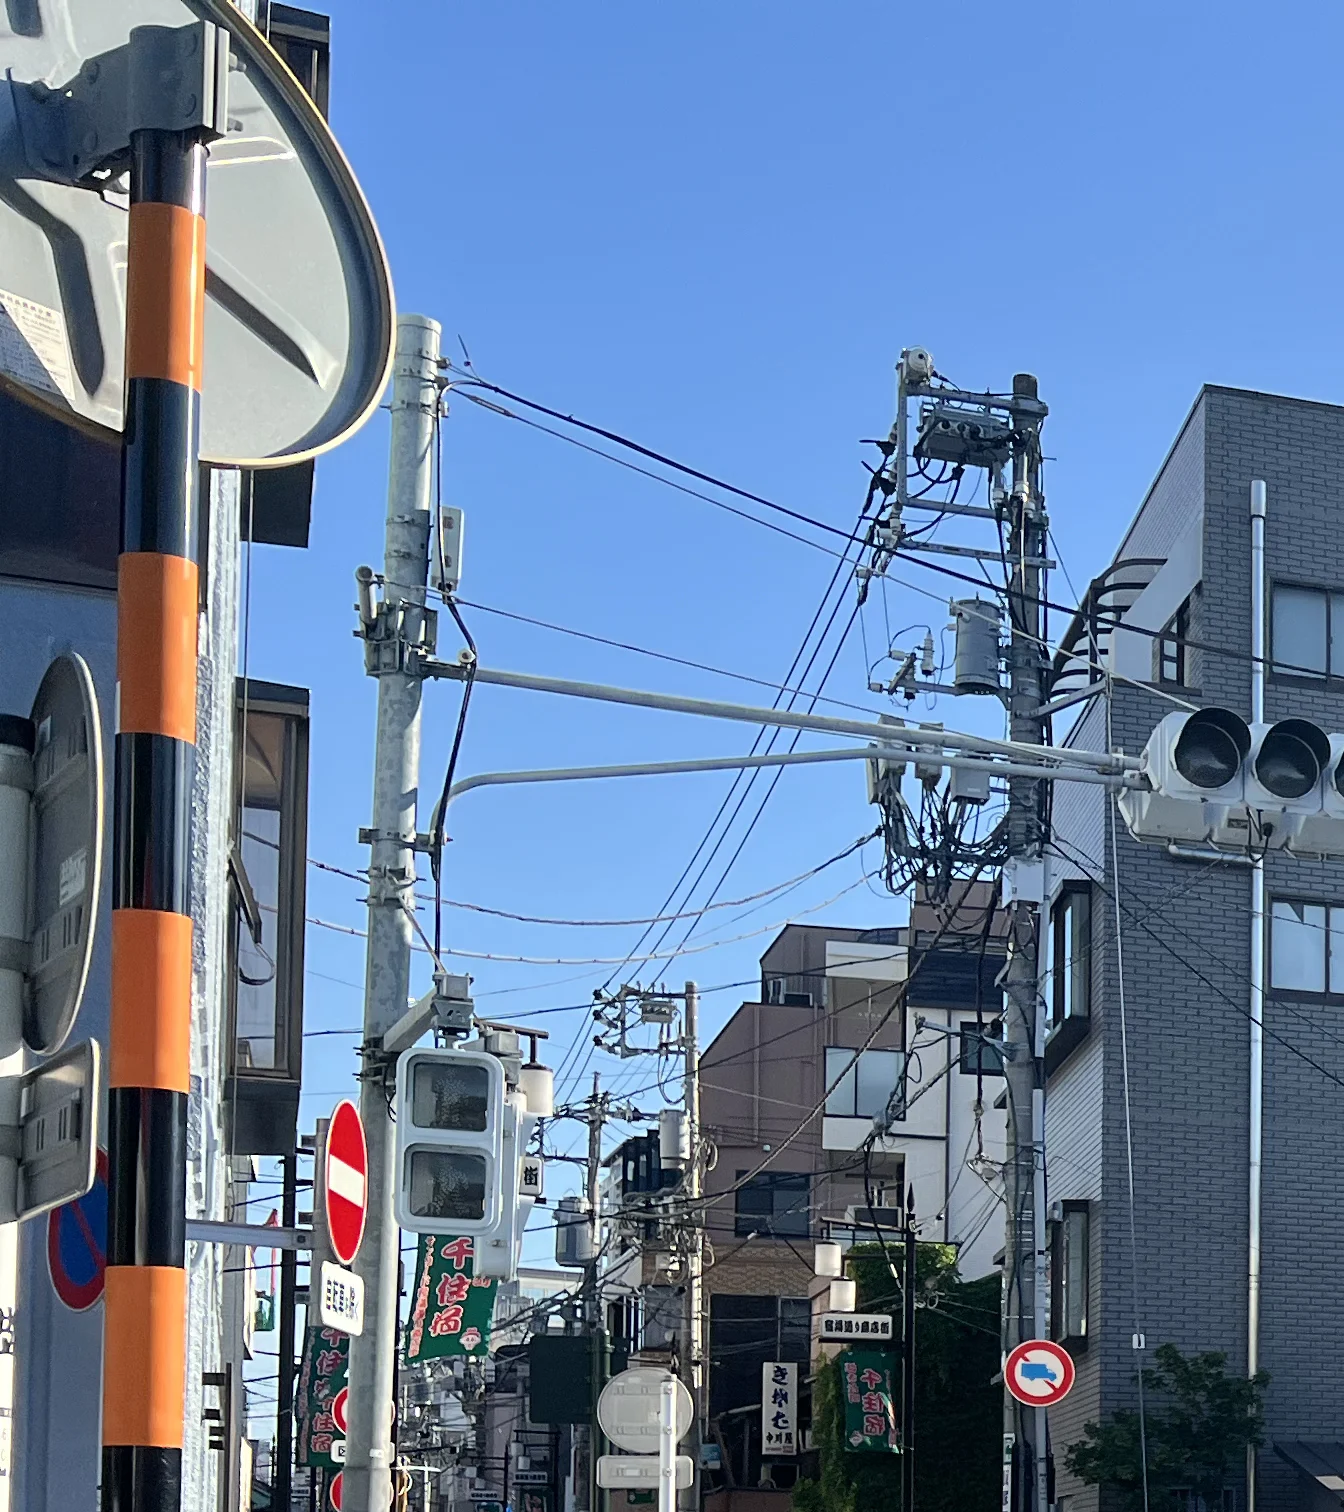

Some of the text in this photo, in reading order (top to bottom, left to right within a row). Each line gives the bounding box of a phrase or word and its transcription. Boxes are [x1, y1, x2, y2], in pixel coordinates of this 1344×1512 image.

[428, 1237, 474, 1337] 千住宿
[860, 1368, 886, 1436] 千住宿
